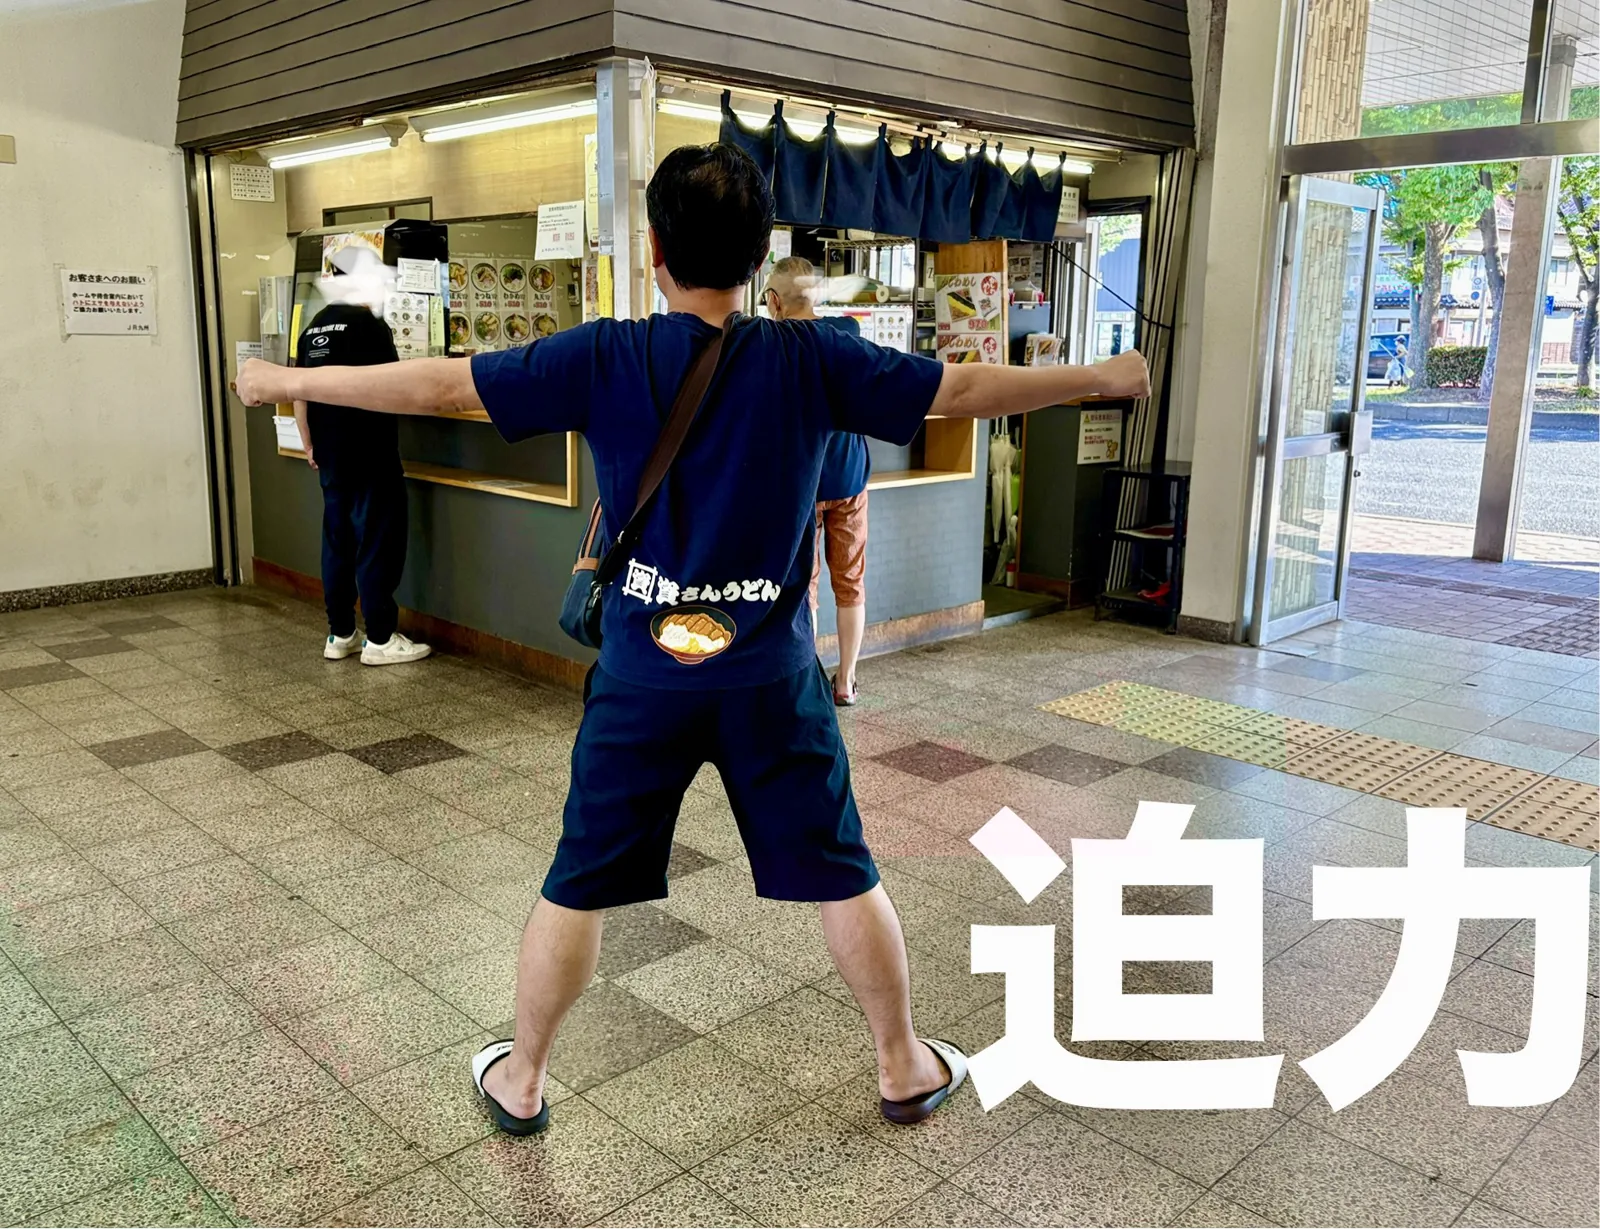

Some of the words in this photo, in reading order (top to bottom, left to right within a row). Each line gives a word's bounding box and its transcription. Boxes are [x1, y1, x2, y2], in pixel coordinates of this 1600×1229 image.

[69, 273, 146, 284] お客さまへのお願い
[656, 575, 781, 606] 資さんうどん
